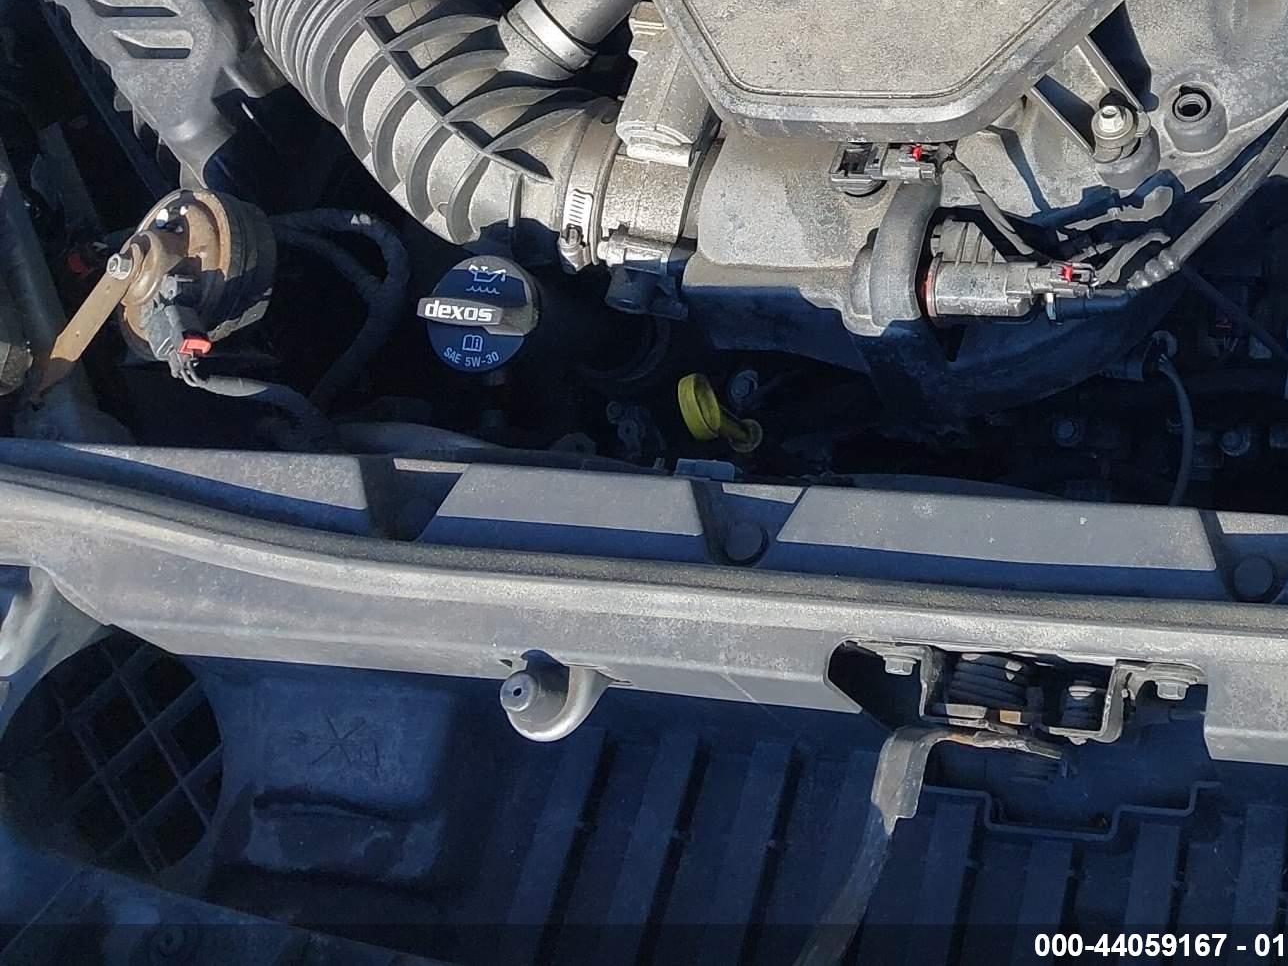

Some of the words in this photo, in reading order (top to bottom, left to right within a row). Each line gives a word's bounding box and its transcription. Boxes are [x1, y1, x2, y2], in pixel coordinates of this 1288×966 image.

[424, 300, 497, 322] dexos
[443, 346, 461, 364] SAE
[465, 351, 500, 368] 5W-30
